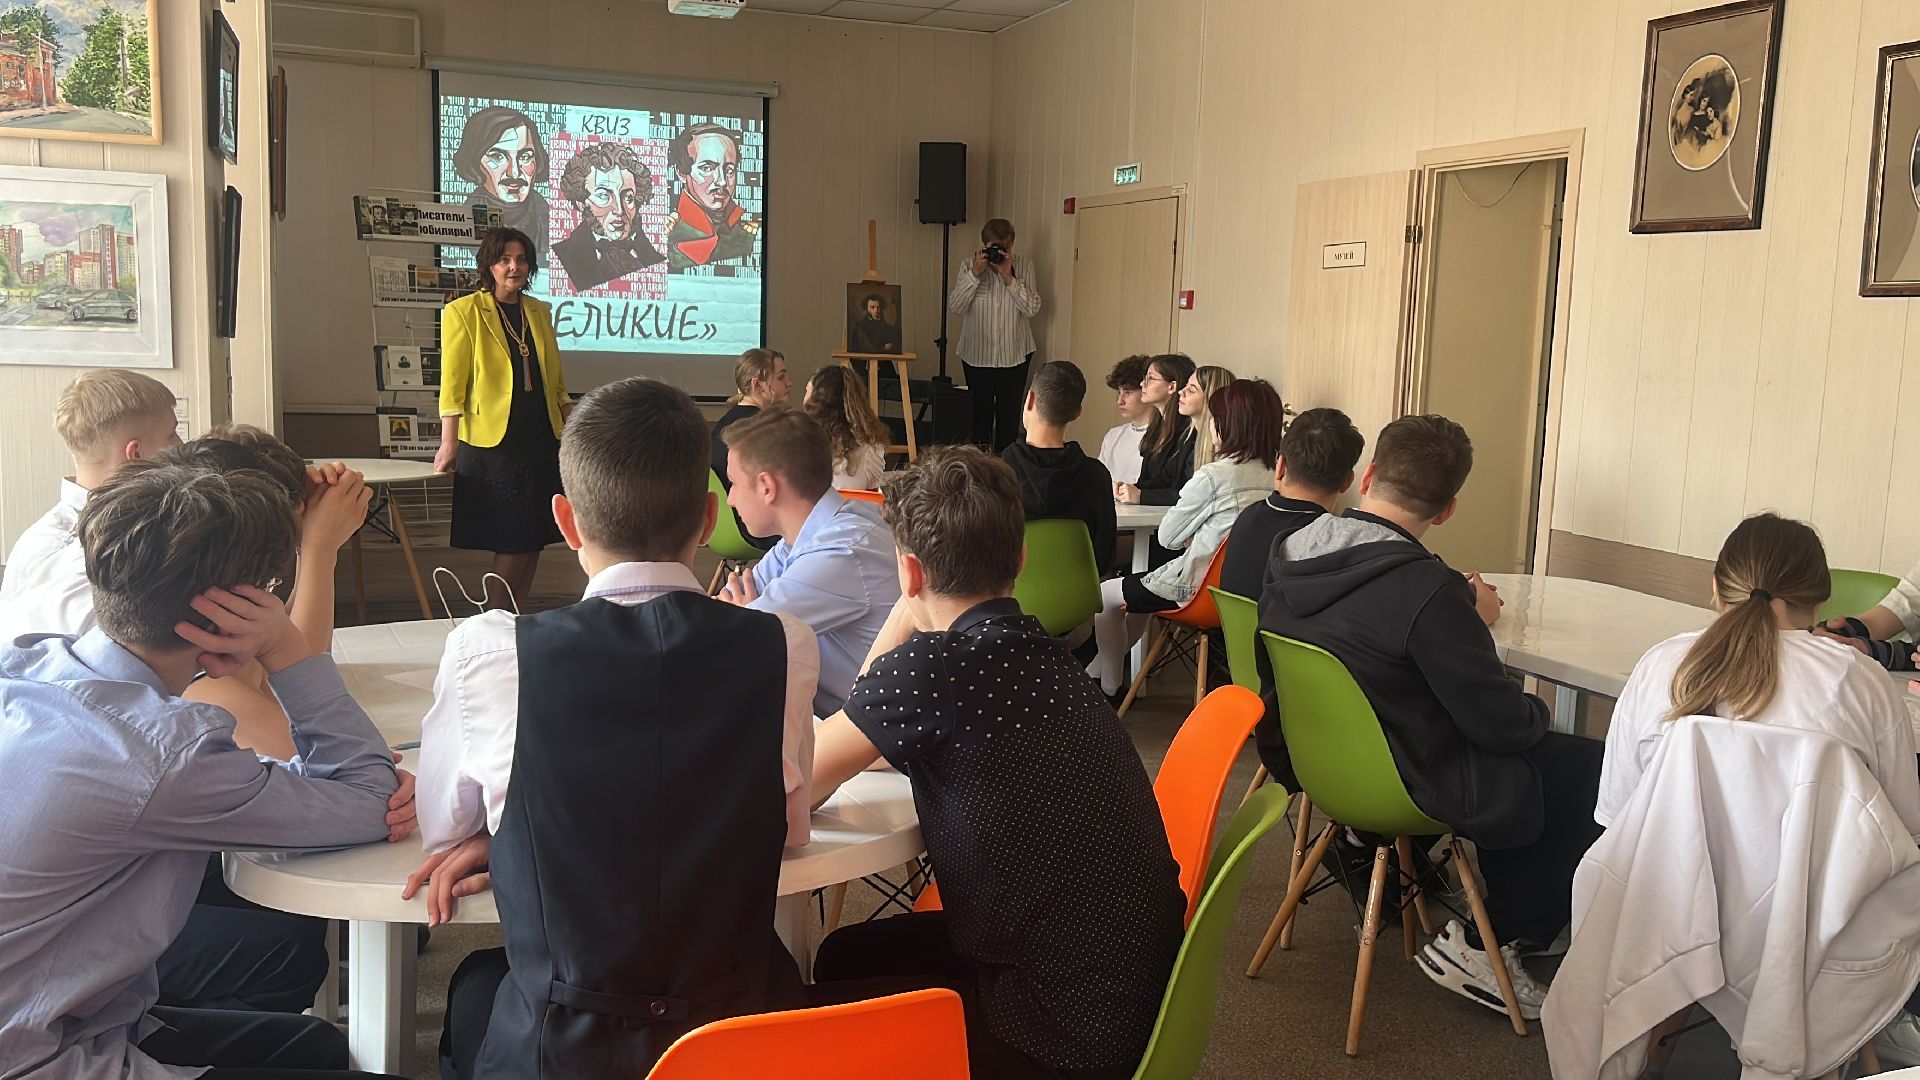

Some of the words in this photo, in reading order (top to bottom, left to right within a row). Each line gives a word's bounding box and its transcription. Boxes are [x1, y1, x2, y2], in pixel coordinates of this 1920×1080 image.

[581, 115, 632, 136] КВИЗ
[419, 225, 473, 238] юбиляры!
[551, 301, 718, 341] ЕЛИКИЕ»
